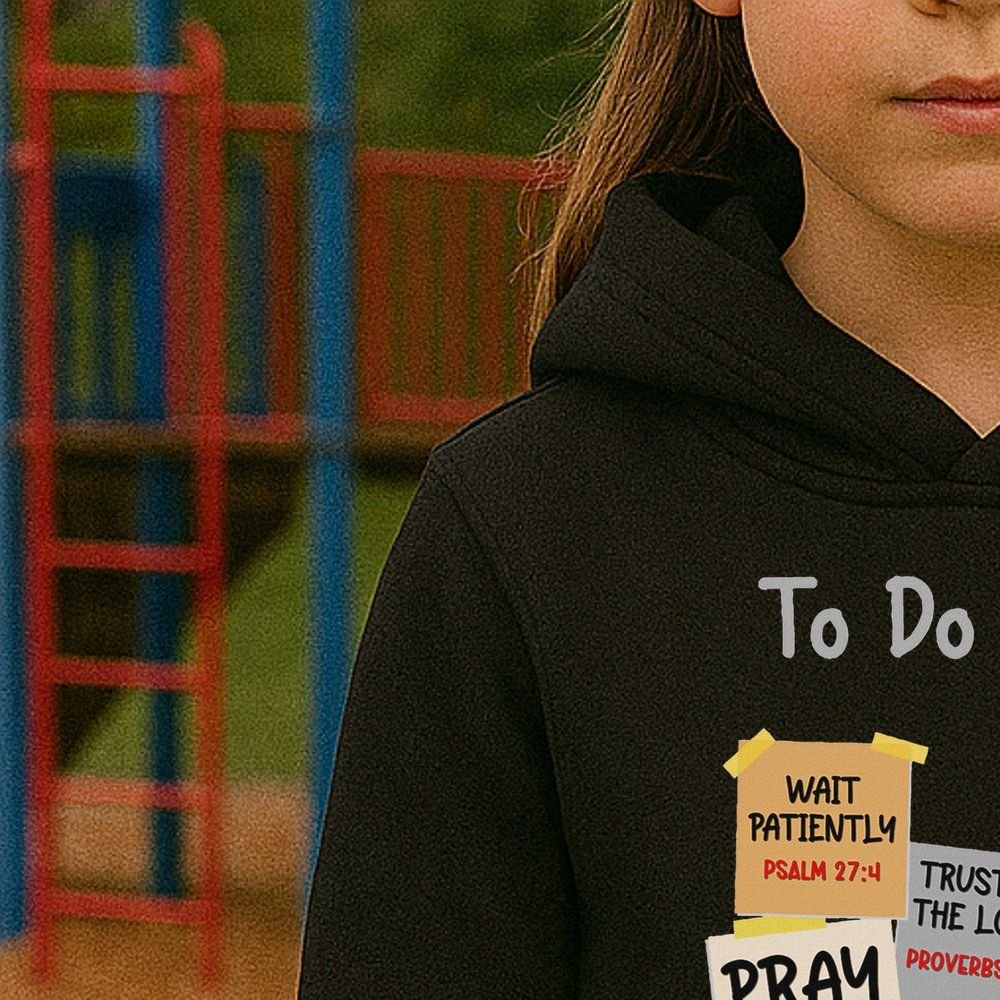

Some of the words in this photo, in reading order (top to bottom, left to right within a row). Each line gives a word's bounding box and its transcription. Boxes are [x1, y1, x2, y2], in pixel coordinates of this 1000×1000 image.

[758, 576, 849, 660] To
[885, 575, 975, 660] Do
[786, 775, 860, 804] WAIT
[748, 813, 897, 844] PATIENTLY
[763, 859, 826, 882] PSALM
[834, 860, 881, 882] 27:4
[912, 898, 966, 933] THE
